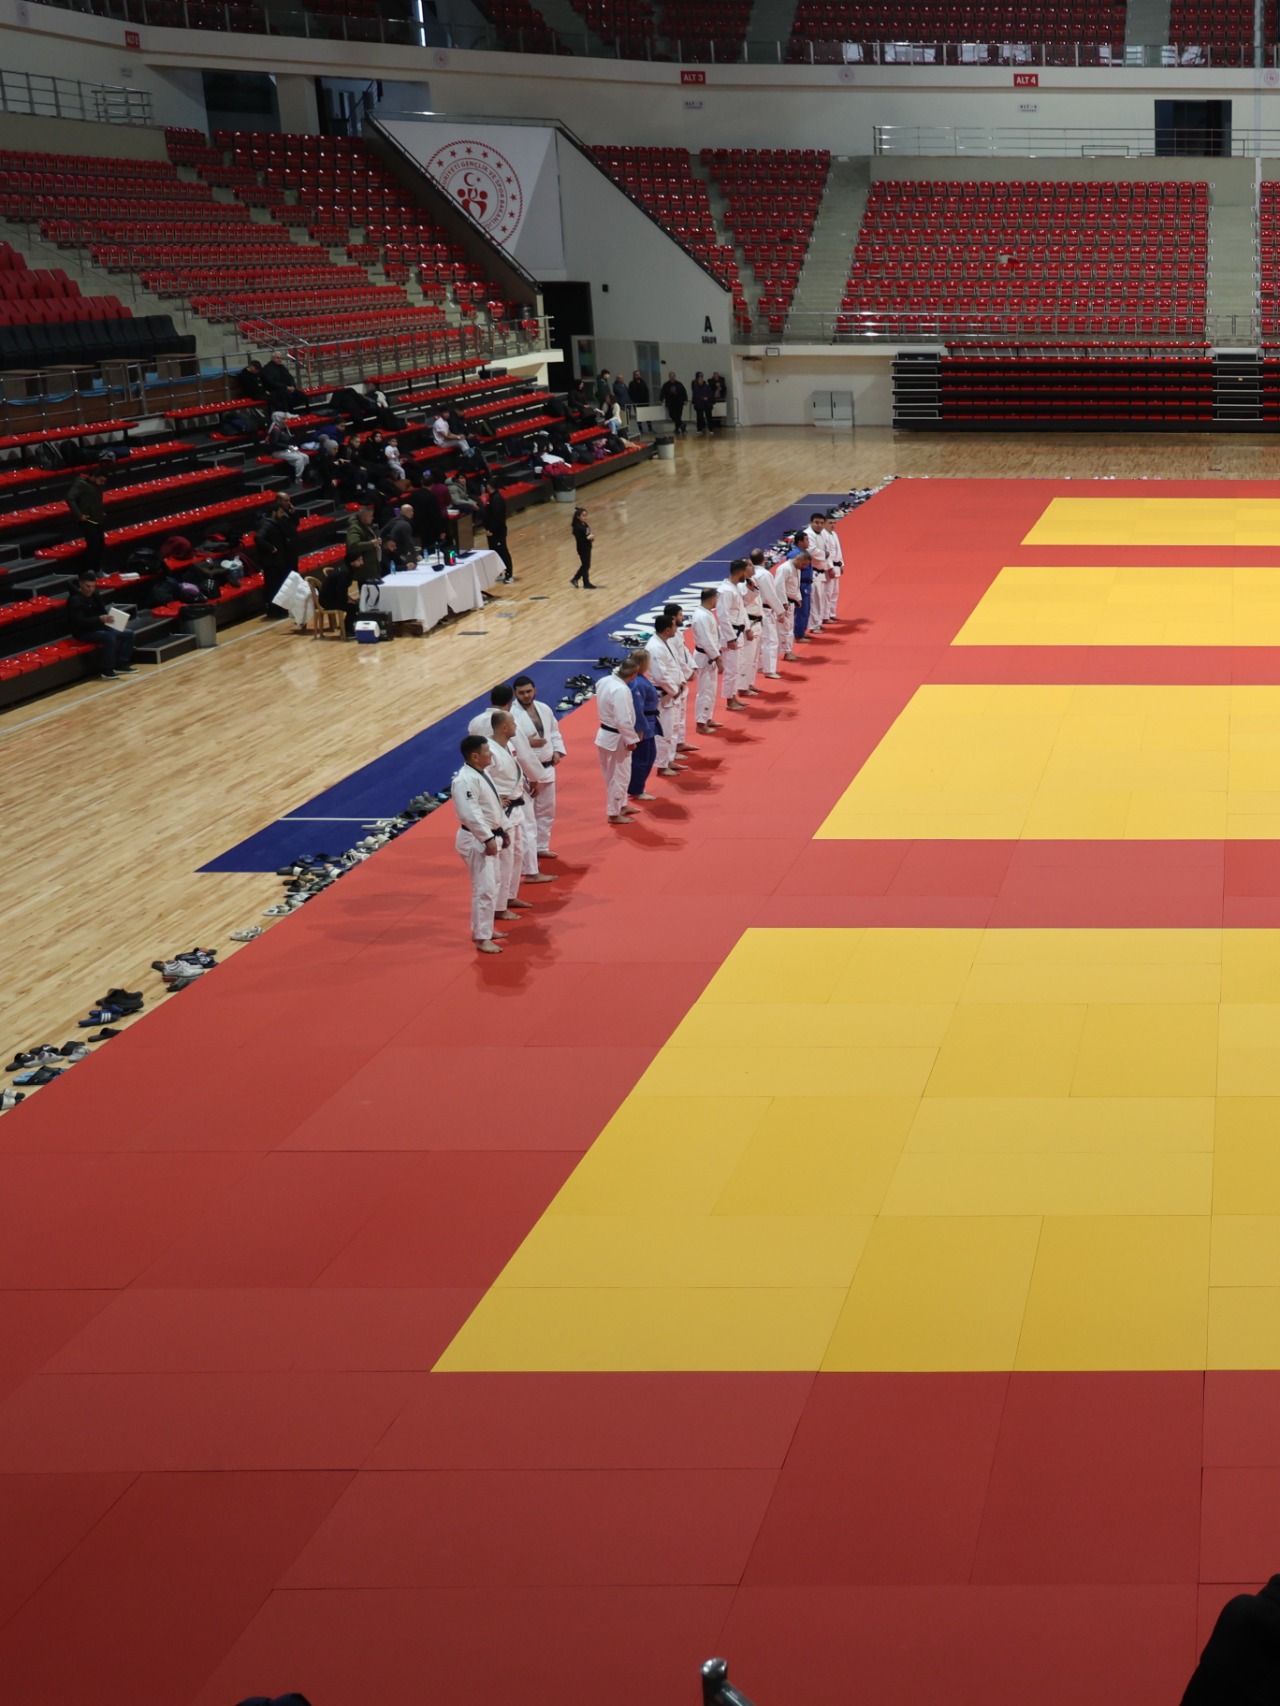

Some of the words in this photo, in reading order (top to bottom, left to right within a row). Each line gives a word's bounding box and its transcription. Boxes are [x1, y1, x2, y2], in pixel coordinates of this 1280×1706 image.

[683, 73, 696, 81] ALT
[1016, 76, 1029, 84] ALT
[1030, 76, 1036, 84] 4
[704, 315, 713, 333] A
